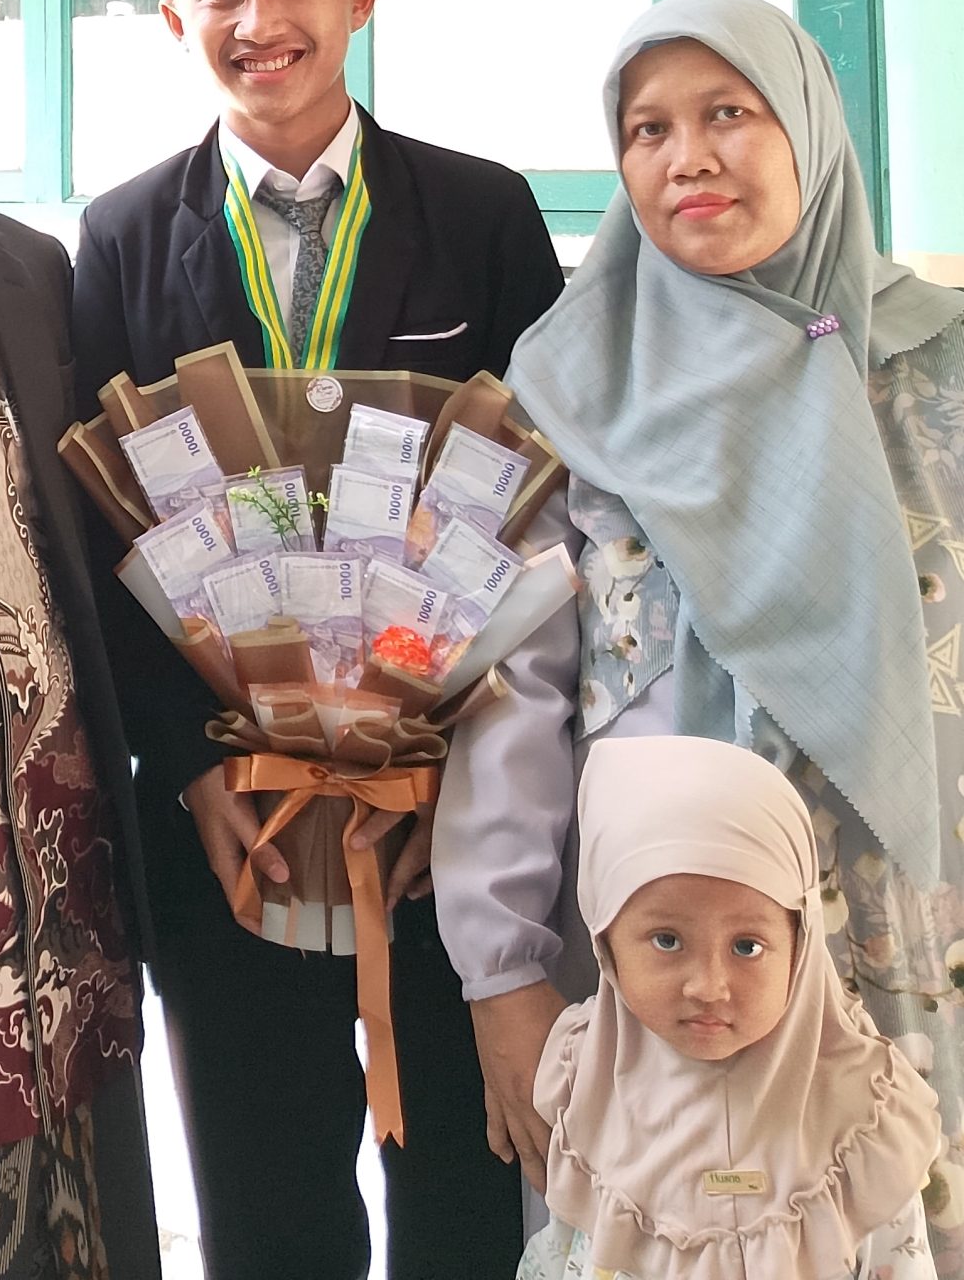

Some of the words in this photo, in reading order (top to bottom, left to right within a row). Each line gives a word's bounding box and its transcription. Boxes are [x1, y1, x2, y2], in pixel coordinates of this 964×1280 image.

[178, 422, 200, 456] 10000
[399, 429, 415, 464] 10000
[493, 462, 515, 497] 10000
[388, 484, 403, 521] 10000
[192, 517, 217, 552] 10000
[259, 560, 281, 597] 10000
[339, 562, 352, 600] 10000
[483, 559, 510, 593] 10000
[417, 590, 437, 624] 10000
